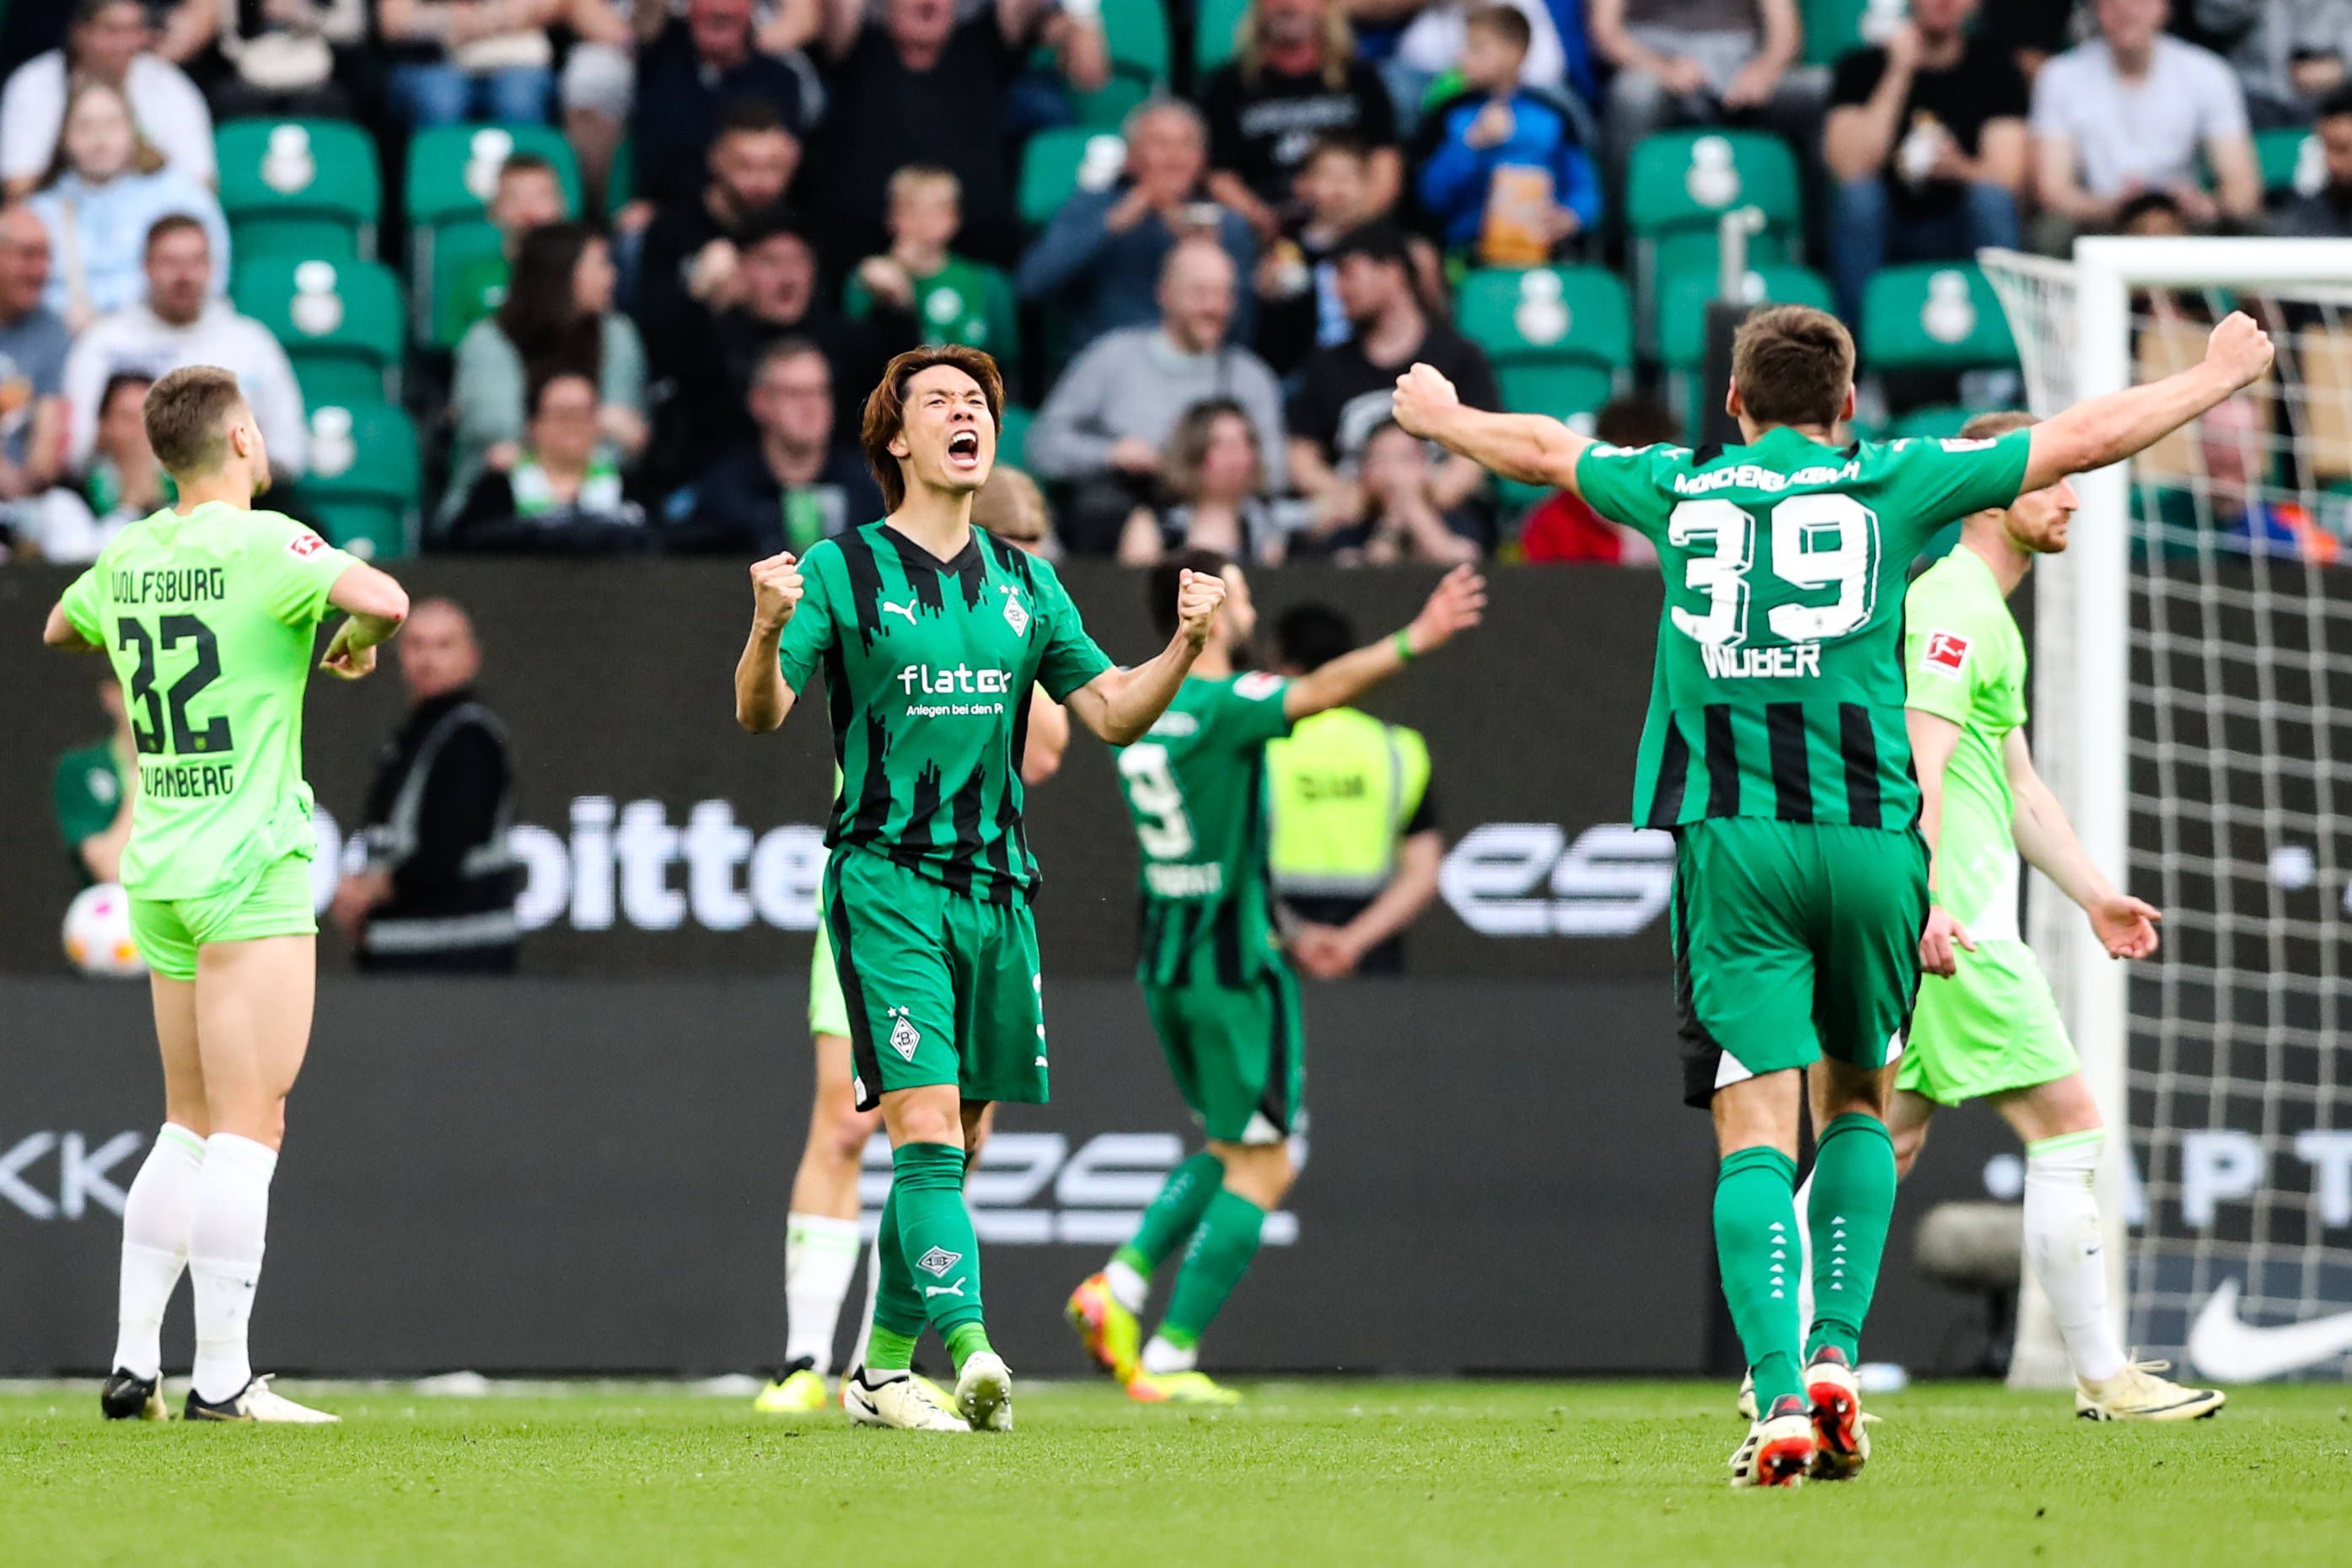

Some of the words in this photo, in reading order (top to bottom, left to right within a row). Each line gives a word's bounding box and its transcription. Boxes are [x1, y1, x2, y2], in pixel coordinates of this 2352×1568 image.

[112, 568, 224, 604] WOLFSBURG
[1668, 493, 1882, 647] 39
[117, 614, 234, 754] 32
[906, 704, 950, 717] Anlegen
[952, 704, 969, 715] bei
[971, 703, 992, 715] den
